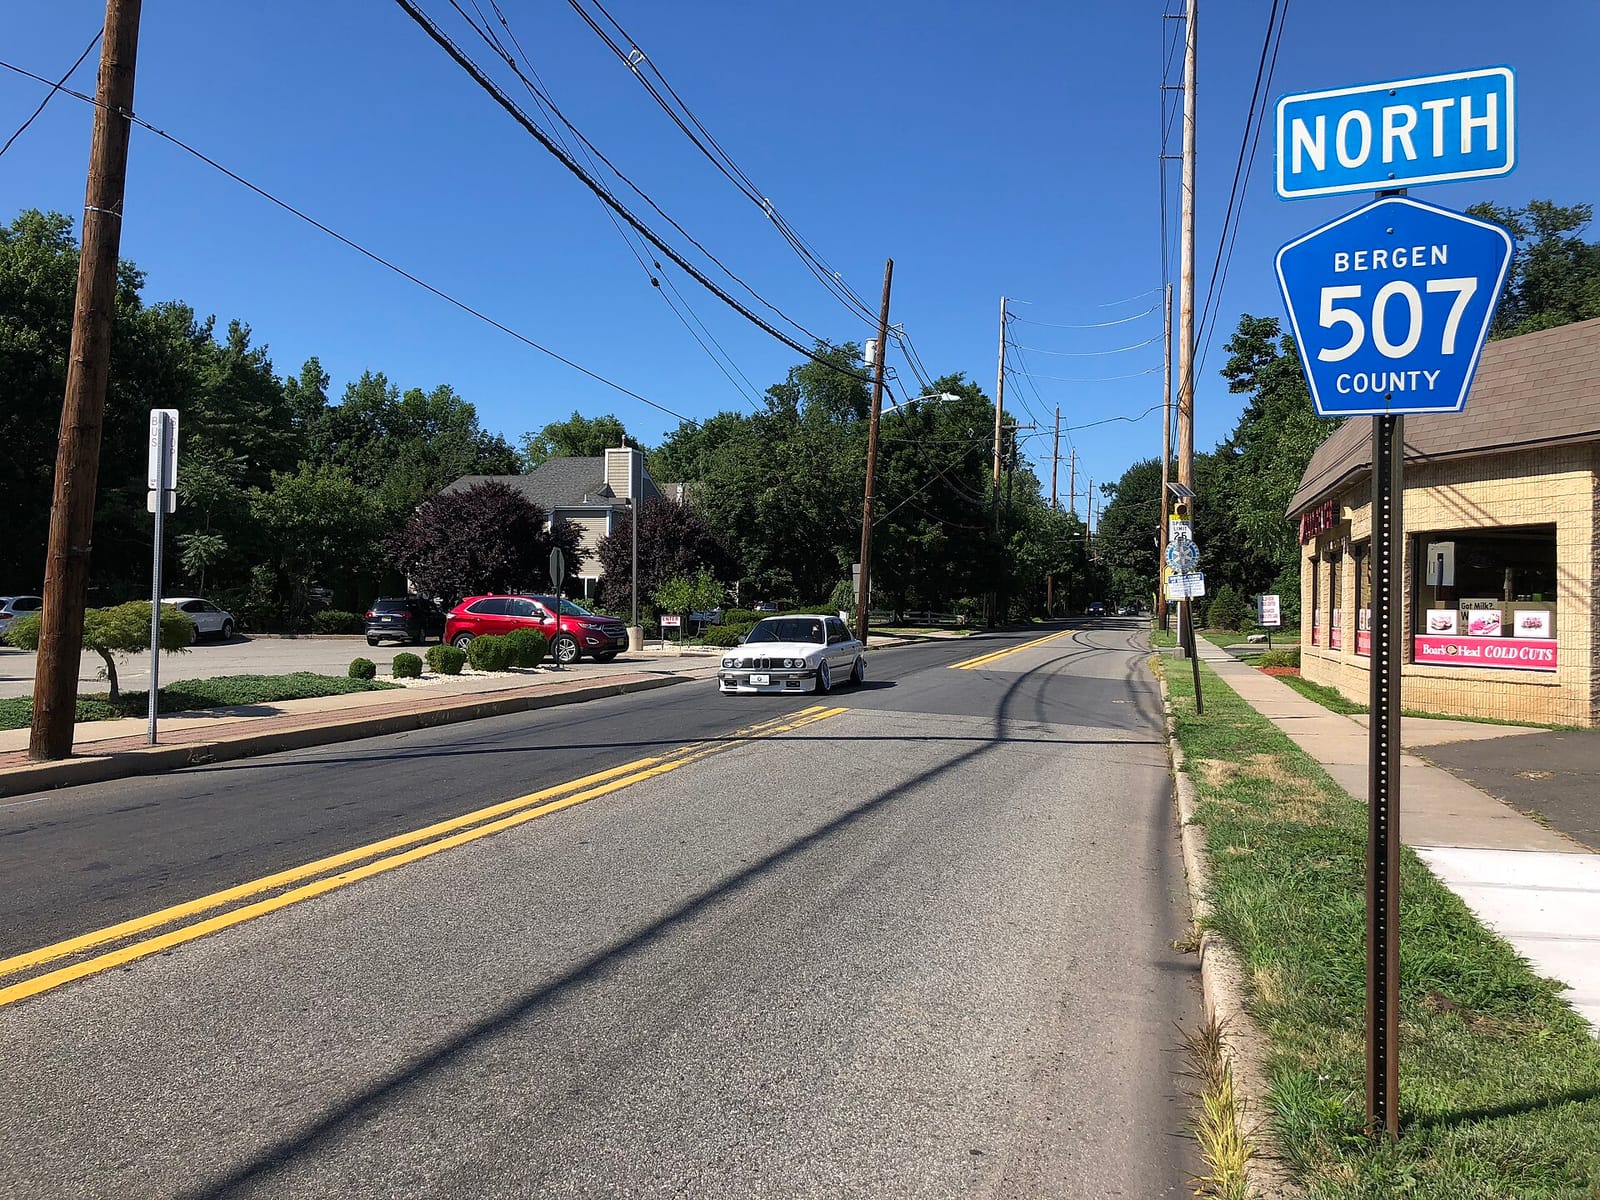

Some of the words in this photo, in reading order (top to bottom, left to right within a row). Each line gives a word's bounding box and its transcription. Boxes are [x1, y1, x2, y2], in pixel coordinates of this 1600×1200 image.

[1291, 92, 1498, 174] NORTH
[1334, 244, 1449, 273] BERGEN
[1317, 277, 1478, 362] 507
[1336, 369, 1441, 394] COUNTY
[1174, 531, 1187, 541] 25
[1460, 602, 1472, 610] Got
[1422, 643, 1447, 656] Boar's
[1457, 645, 1480, 657] Head
[1484, 645, 1518, 659] COLD
[1520, 646, 1553, 661] CUTS
